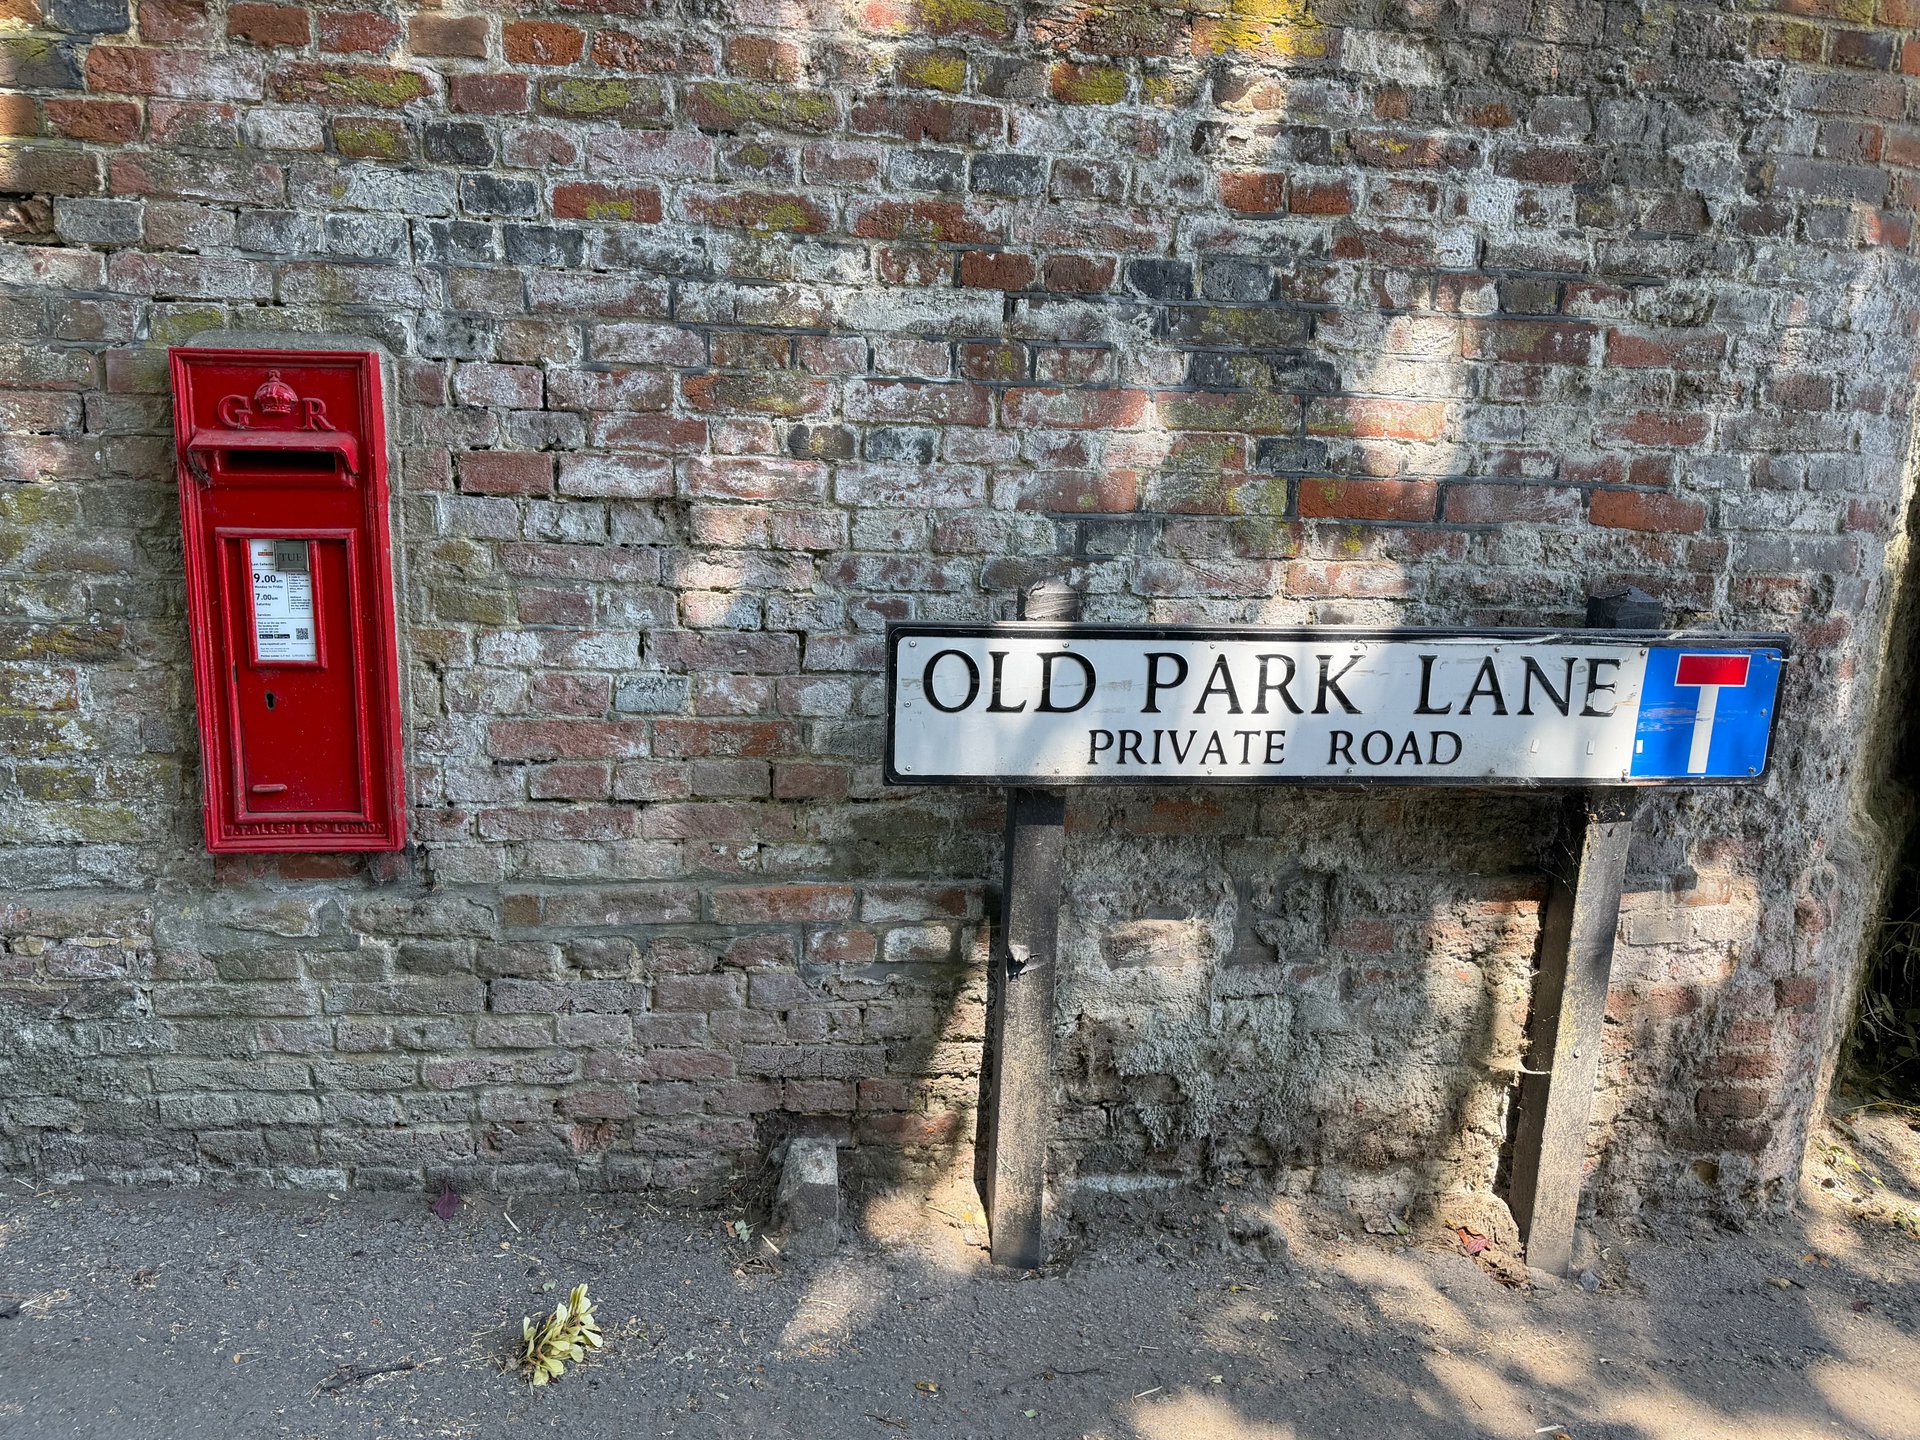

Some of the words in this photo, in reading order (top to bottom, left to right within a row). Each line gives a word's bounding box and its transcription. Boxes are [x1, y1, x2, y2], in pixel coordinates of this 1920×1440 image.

[217, 394, 253, 430] G
[302, 397, 336, 431] R
[279, 552, 303, 562] TUE
[923, 649, 1097, 713] OLD
[1141, 651, 1367, 715] PARK
[1413, 654, 1621, 717] LANE
[1087, 729, 1286, 765] PRIVATE
[1327, 730, 1463, 765] ROAD
